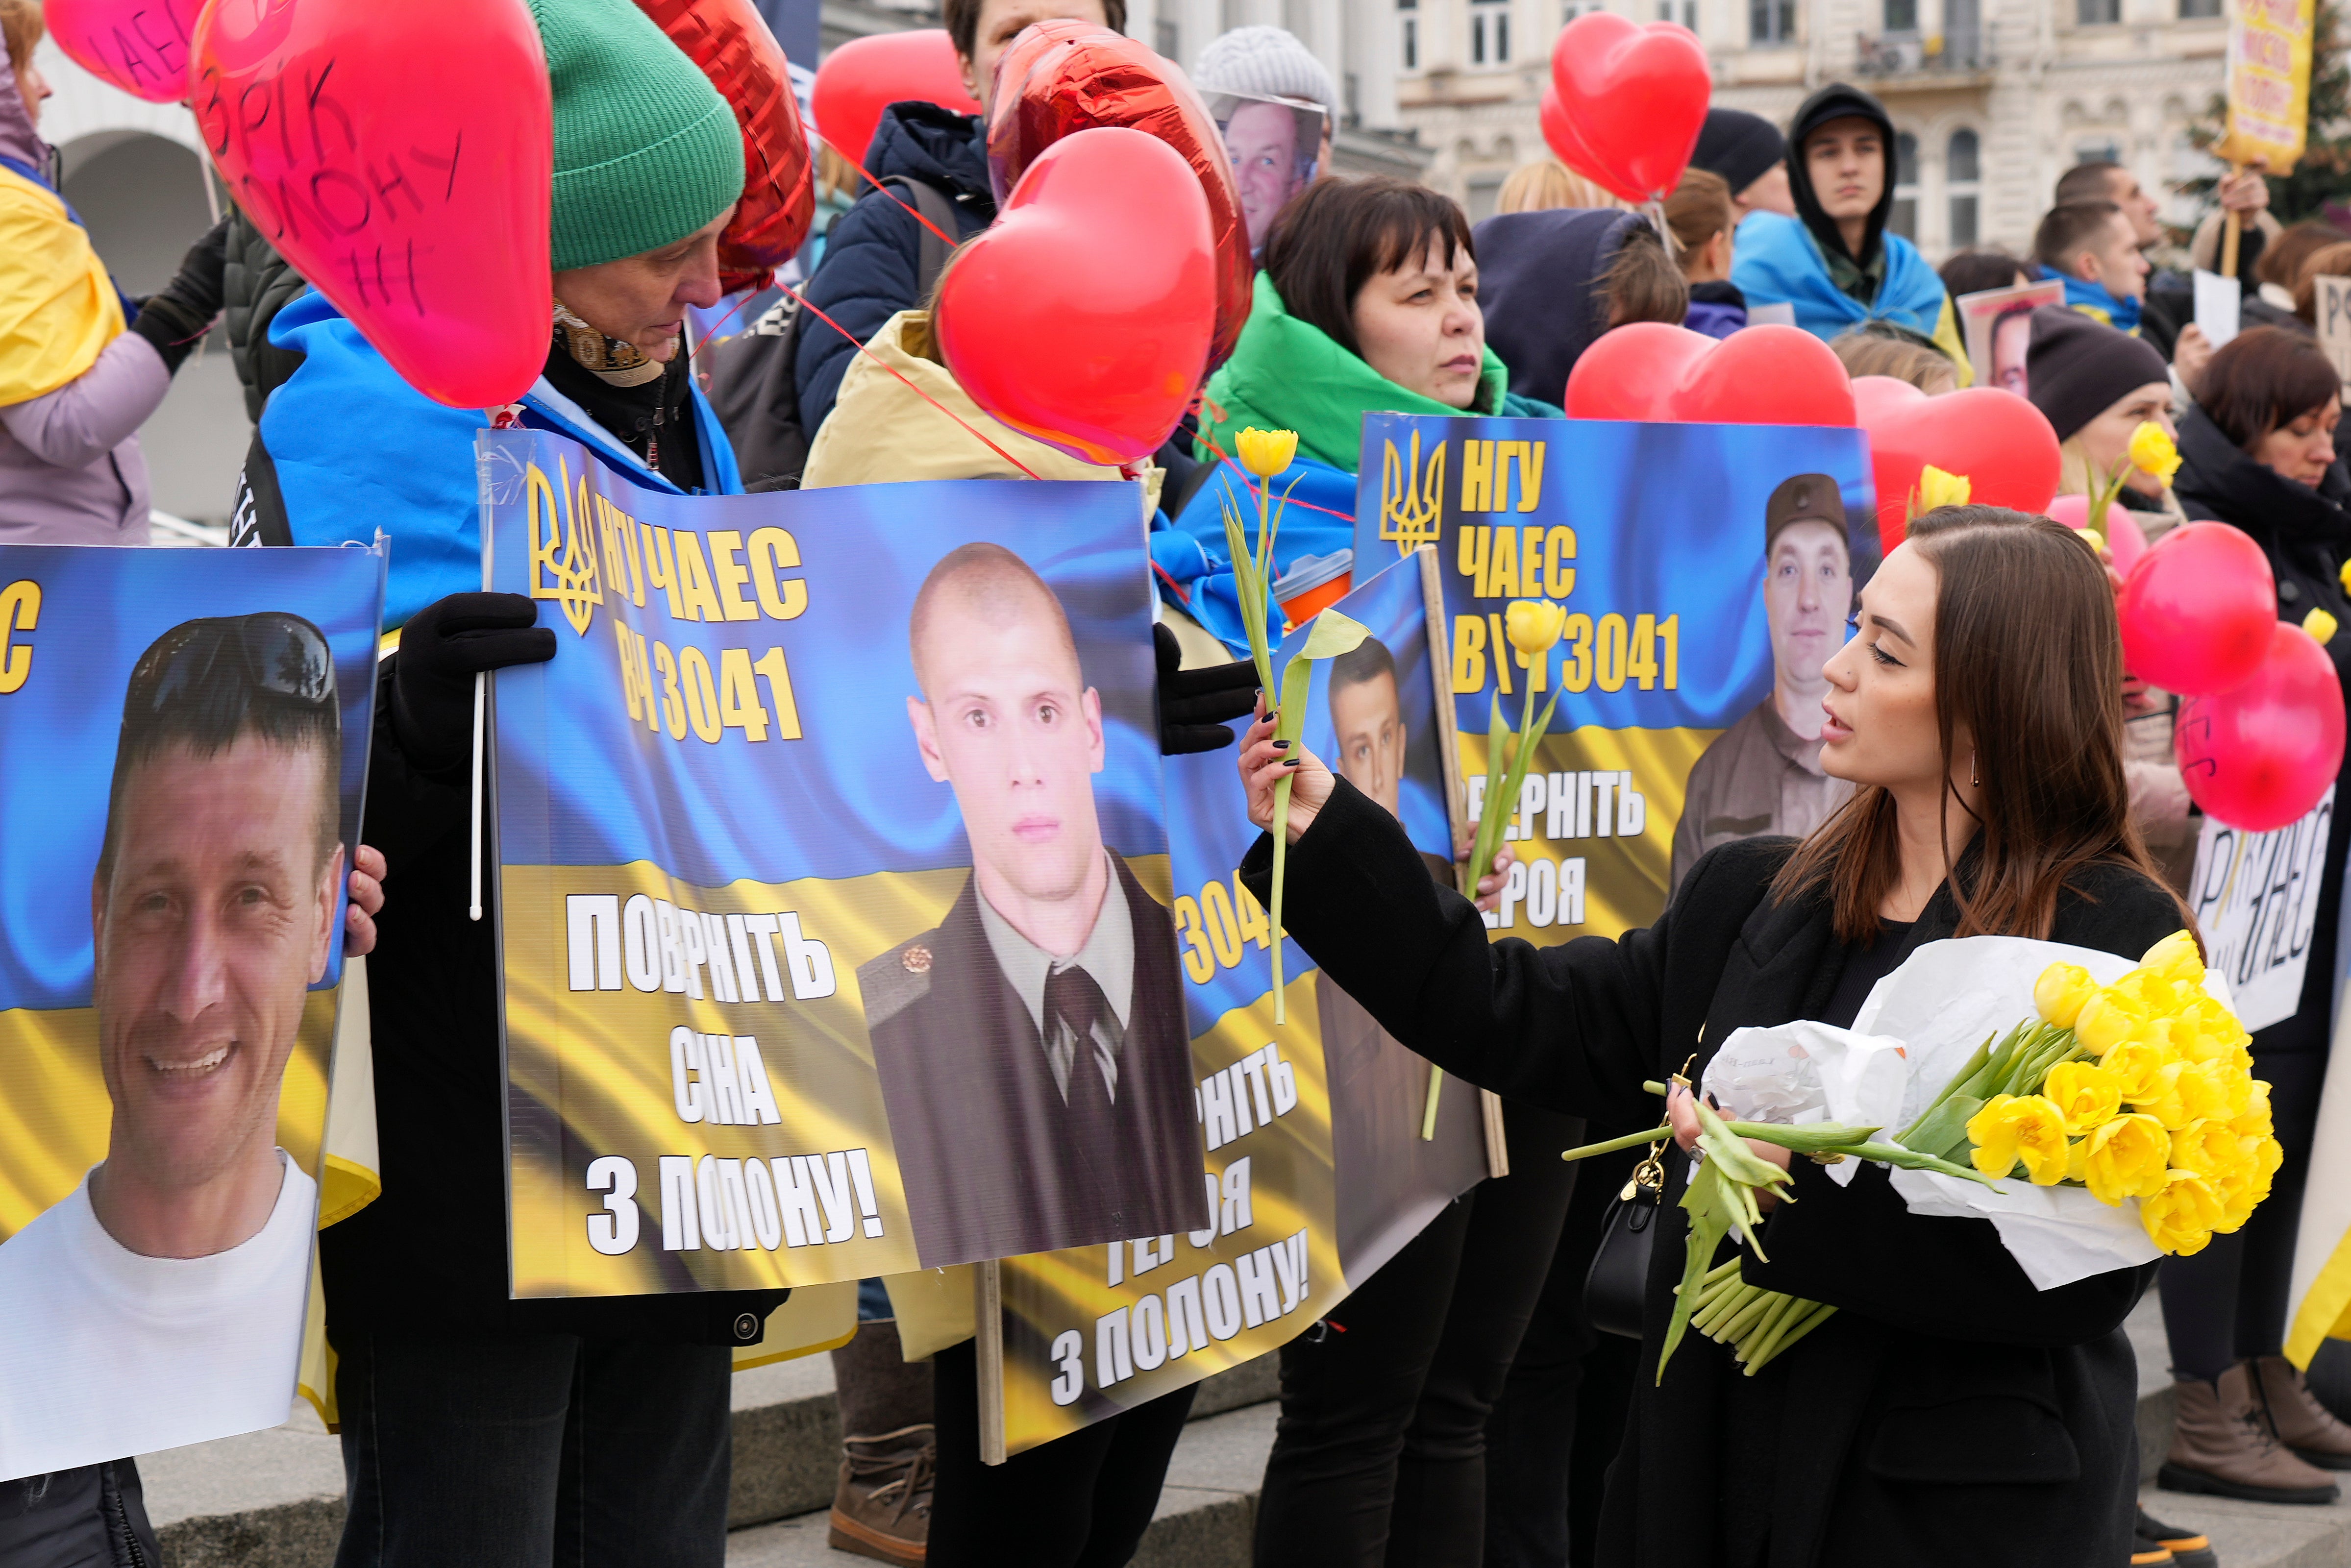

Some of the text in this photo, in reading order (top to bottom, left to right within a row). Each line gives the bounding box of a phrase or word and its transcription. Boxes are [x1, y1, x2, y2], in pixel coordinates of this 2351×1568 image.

[239, 126, 459, 241] ОЛОНУ
[1460, 439, 1546, 513] НГУ
[1458, 525, 1577, 599] ЧАЕС
[653, 640, 803, 744] 3041
[1561, 612, 1679, 694] 3041
[1174, 868, 1289, 984] 304
[1194, 1041, 1298, 1152] НІТЬ
[658, 1148, 884, 1251] ПОЛОНУ!
[1095, 1226, 1309, 1389] ПОЛОНУ!
